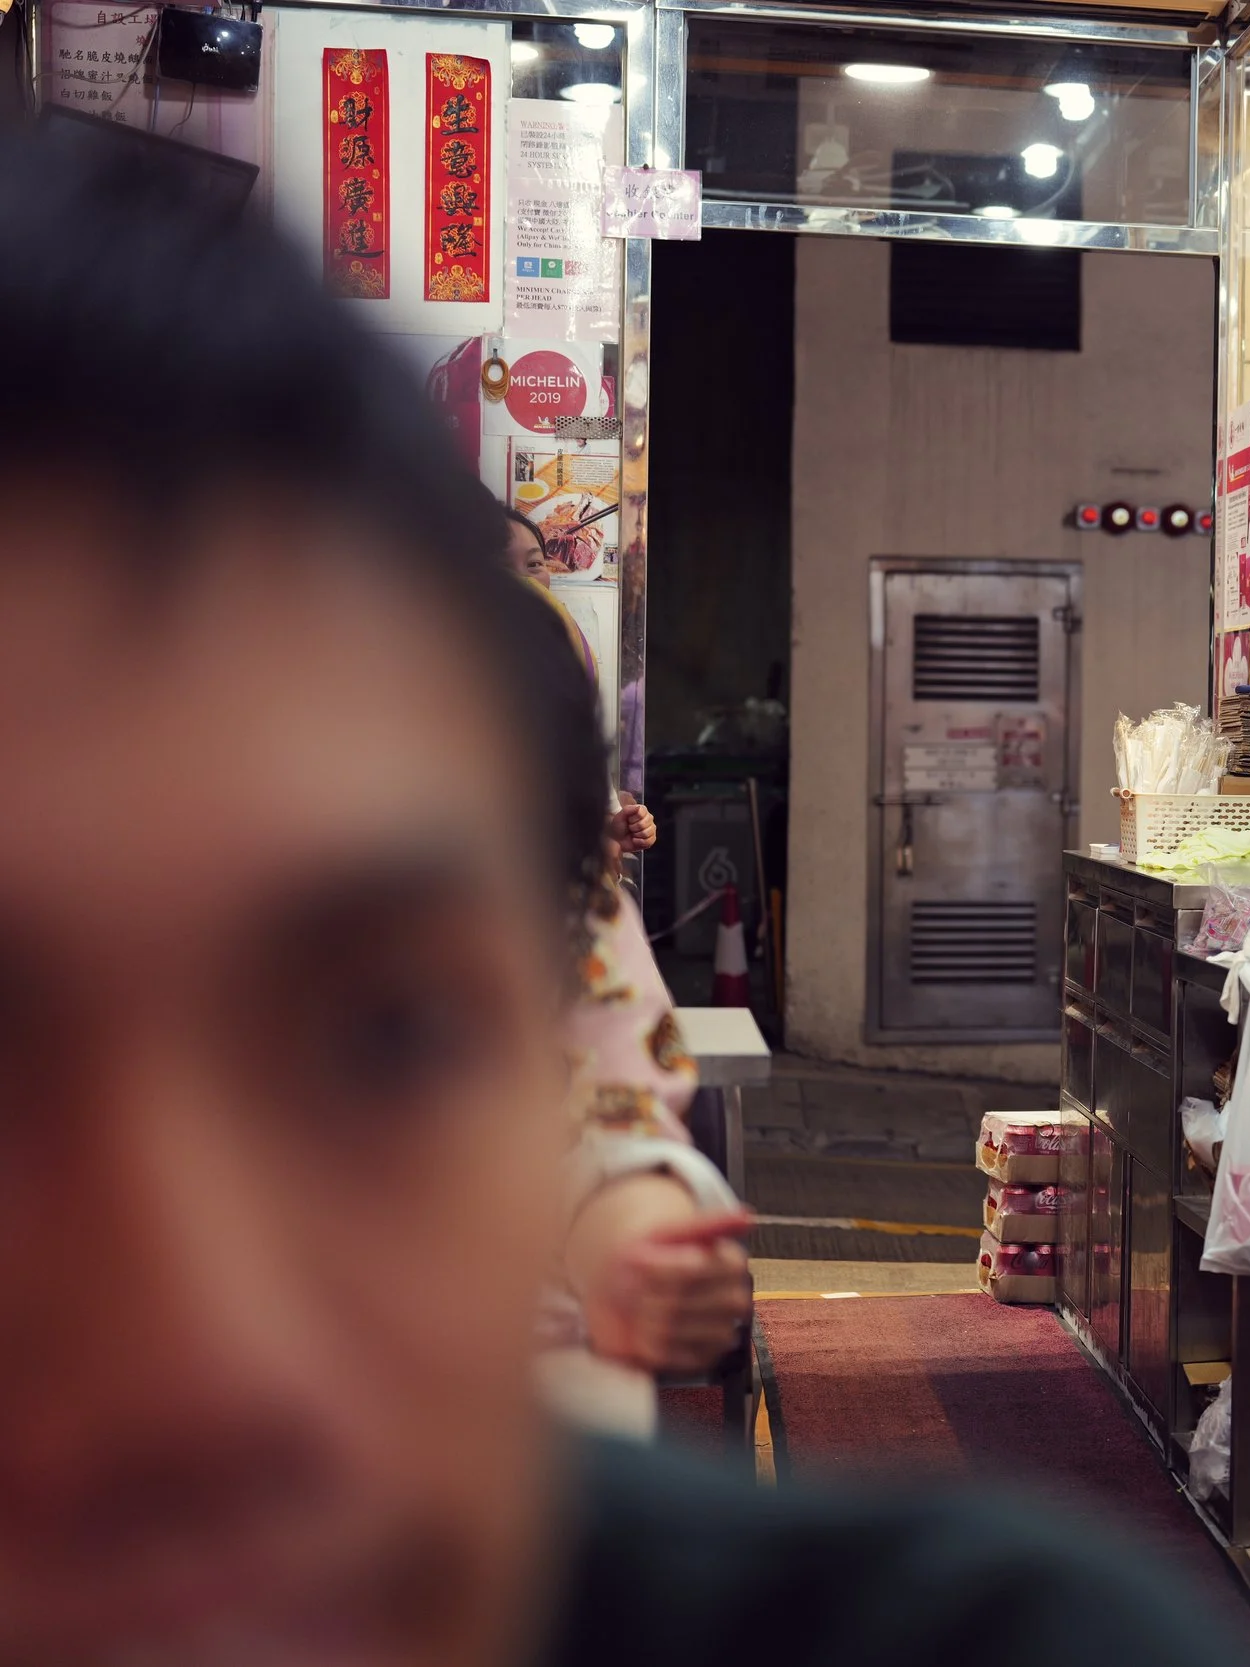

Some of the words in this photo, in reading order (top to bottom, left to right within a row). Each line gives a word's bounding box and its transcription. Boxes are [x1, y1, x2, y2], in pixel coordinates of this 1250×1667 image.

[339, 97, 384, 257] 財源廣進
[438, 95, 482, 257] 生意興隆
[510, 376, 580, 388] MICHELIN
[529, 392, 561, 404] 2019
